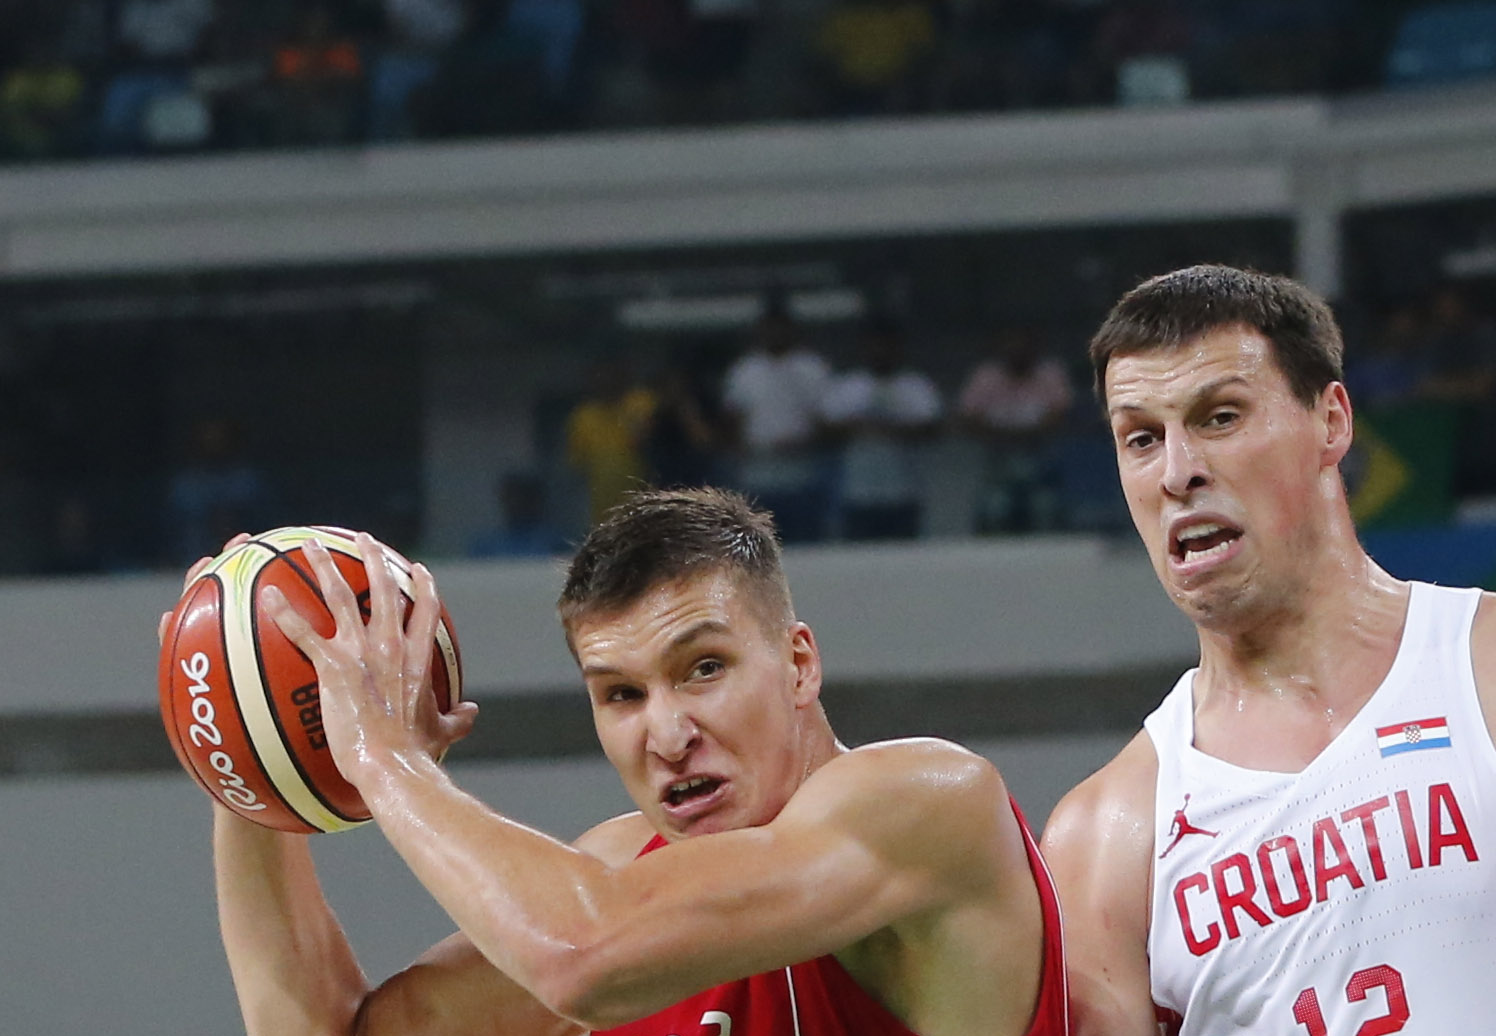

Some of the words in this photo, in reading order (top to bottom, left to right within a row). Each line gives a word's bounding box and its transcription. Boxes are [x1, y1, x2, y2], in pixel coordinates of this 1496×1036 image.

[180, 651, 223, 748] 2016
[209, 751, 267, 811] Rio
[1173, 783, 1479, 957] CROATIA
